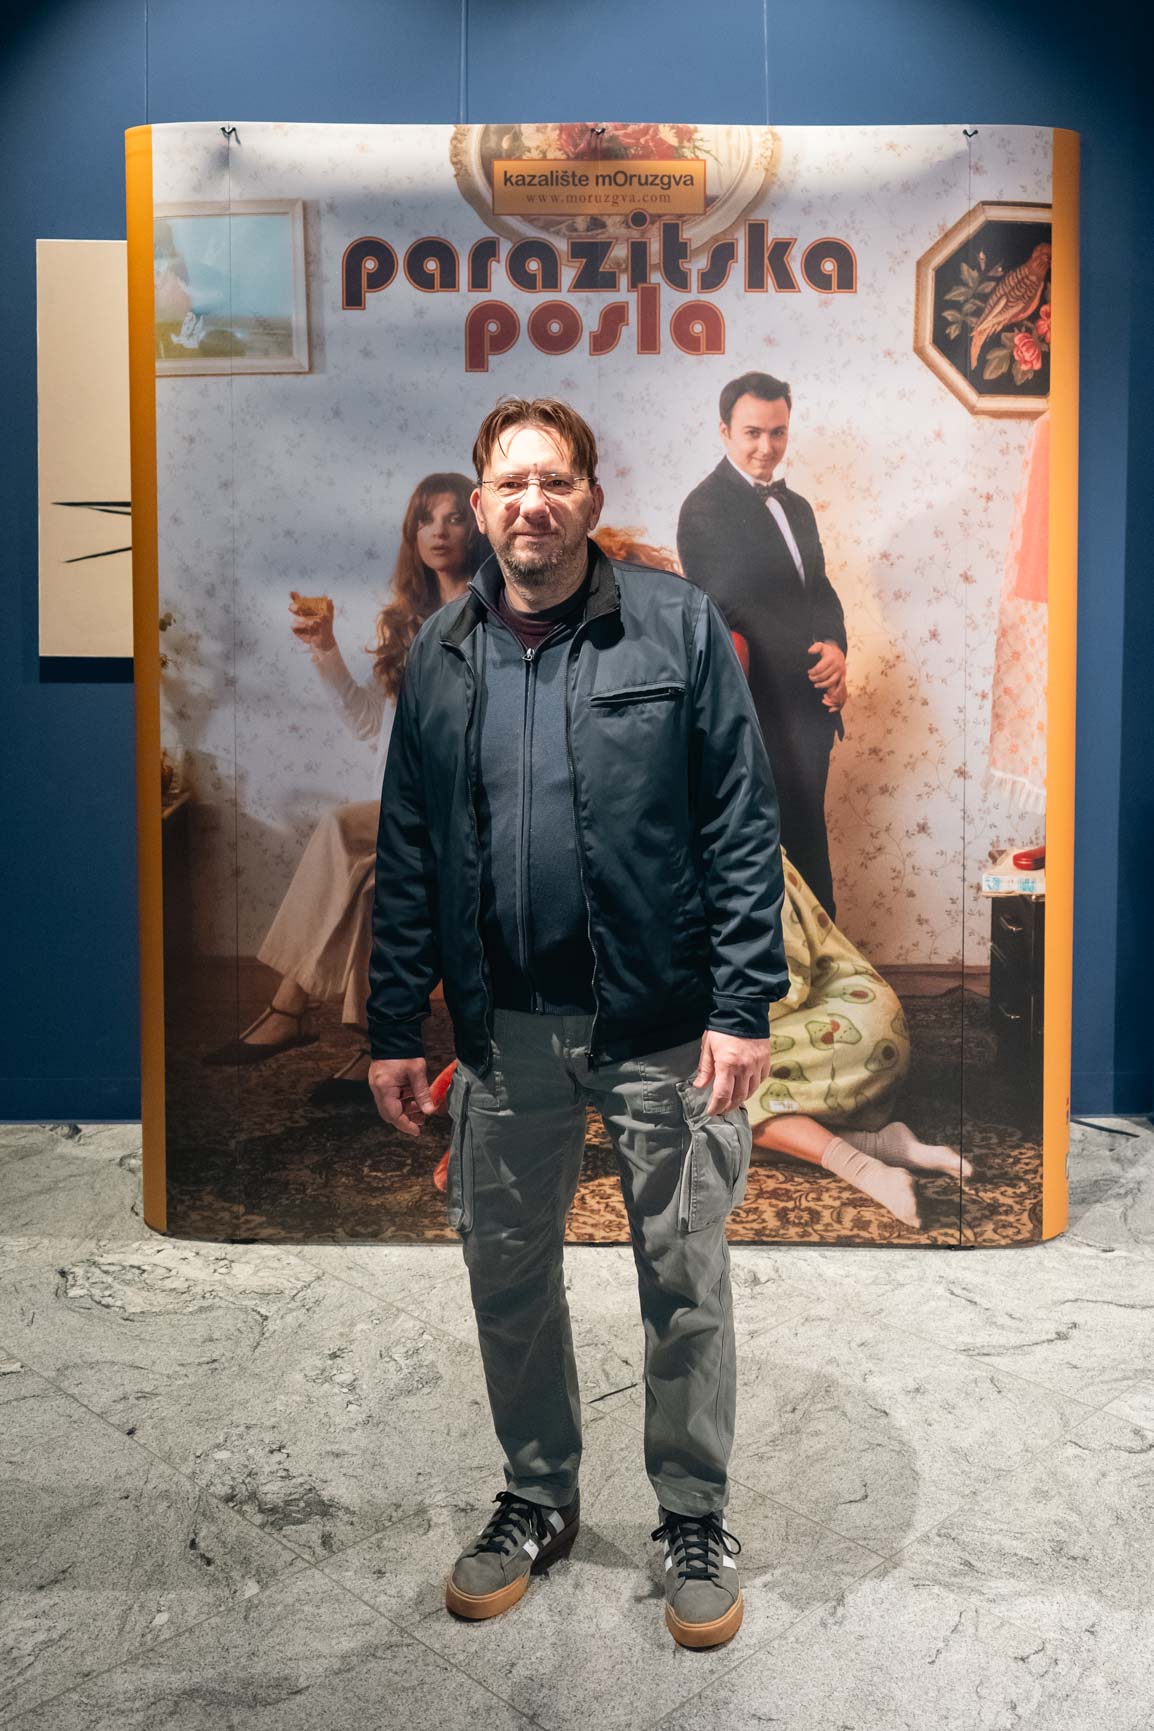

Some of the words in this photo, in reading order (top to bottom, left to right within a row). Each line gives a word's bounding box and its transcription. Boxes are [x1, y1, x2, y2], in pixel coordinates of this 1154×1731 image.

[503, 170, 590, 187] kazalište
[595, 170, 694, 190] mOruzgva
[526, 192, 671, 206] www.moruzgva.com
[342, 208, 858, 310] parazitska
[464, 283, 726, 373] posla
